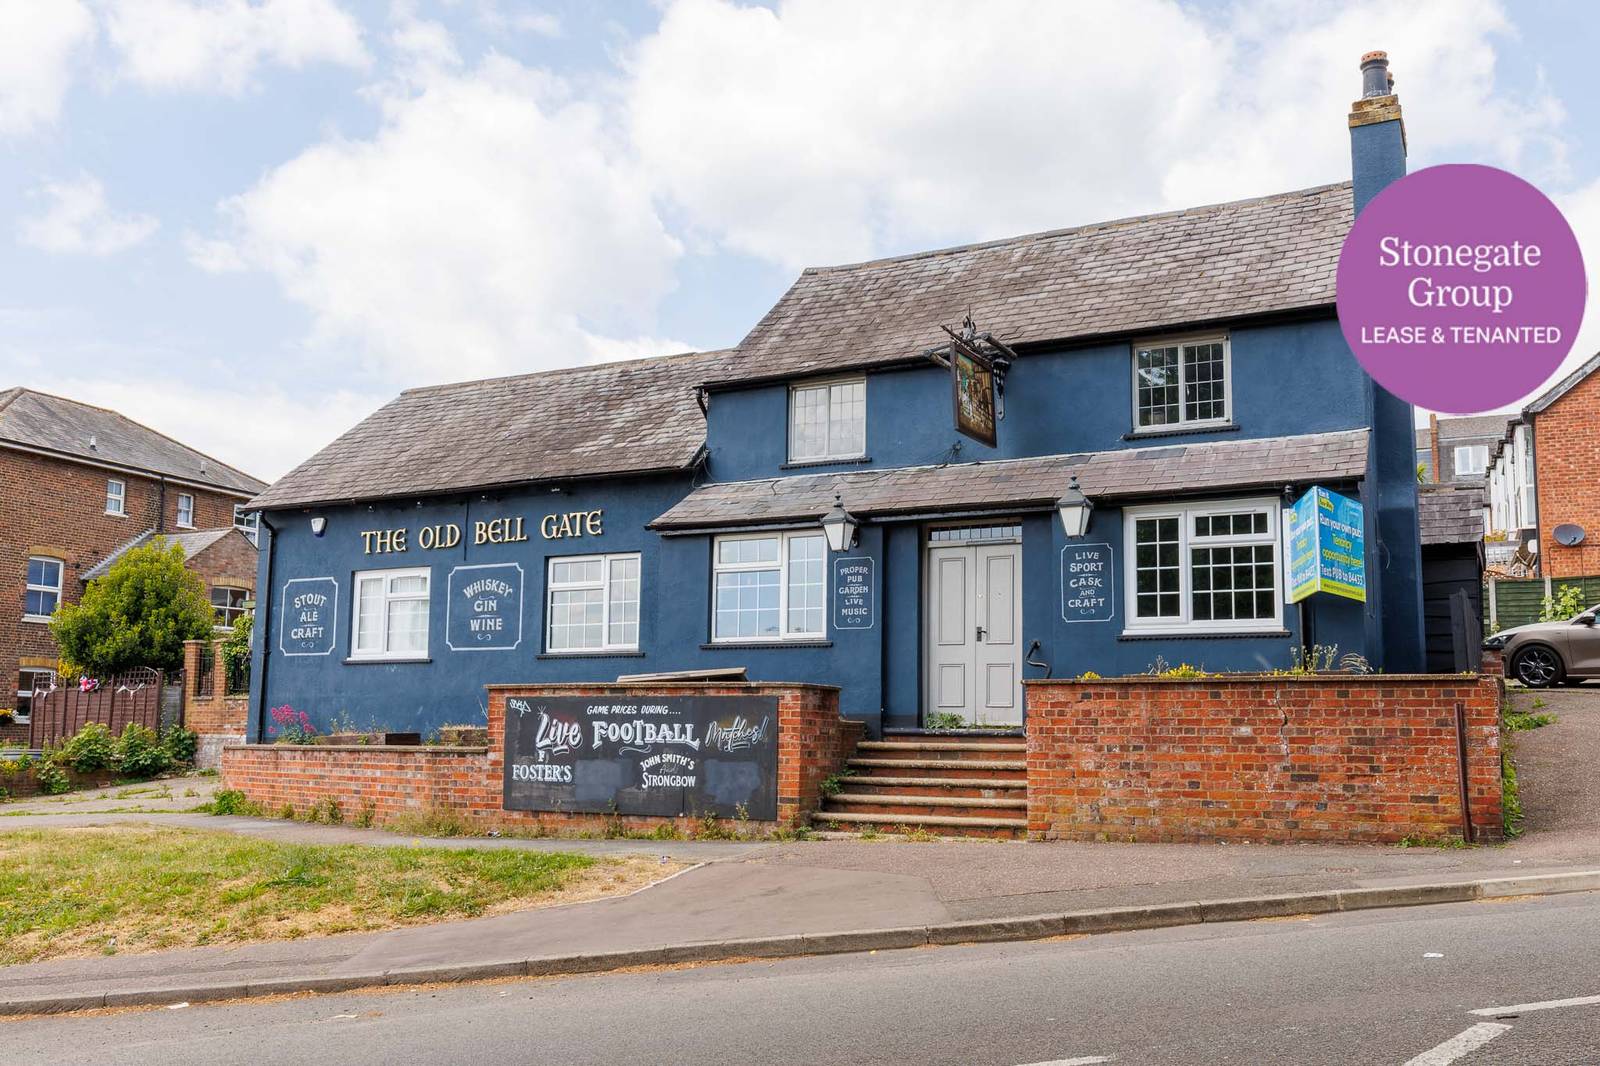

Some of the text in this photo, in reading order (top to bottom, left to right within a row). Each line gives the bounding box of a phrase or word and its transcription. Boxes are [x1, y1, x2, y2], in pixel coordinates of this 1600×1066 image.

[361, 509, 602, 554] THE OLD BELL GATE
[1075, 551, 1100, 560] LIVE
[840, 566, 868, 576] PROPER
[1069, 562, 1103, 573] SPORT
[847, 575, 862, 583] PUB
[1069, 577, 1103, 588] CASK
[463, 579, 513, 599] WHISKEY
[839, 585, 868, 595] GARDEN
[1080, 589, 1095, 597] AND
[294, 593, 327, 609] STOUT
[474, 599, 497, 612] GIN
[1068, 598, 1105, 608] CRAFT
[300, 611, 318, 622] ALE
[842, 607, 867, 616] MUSIC
[470, 618, 503, 631] WINE
[291, 626, 324, 639] CRAFT
[586, 705, 609, 715] GAME
[611, 705, 637, 715] PRICES
[536, 713, 583, 750] Live
[592, 719, 701, 751] FOOTBALL
[640, 753, 695, 771] JOHN SMITH'S
[512, 764, 573, 783] FOSTER'S
[641, 772, 697, 789] STRONGBOW
